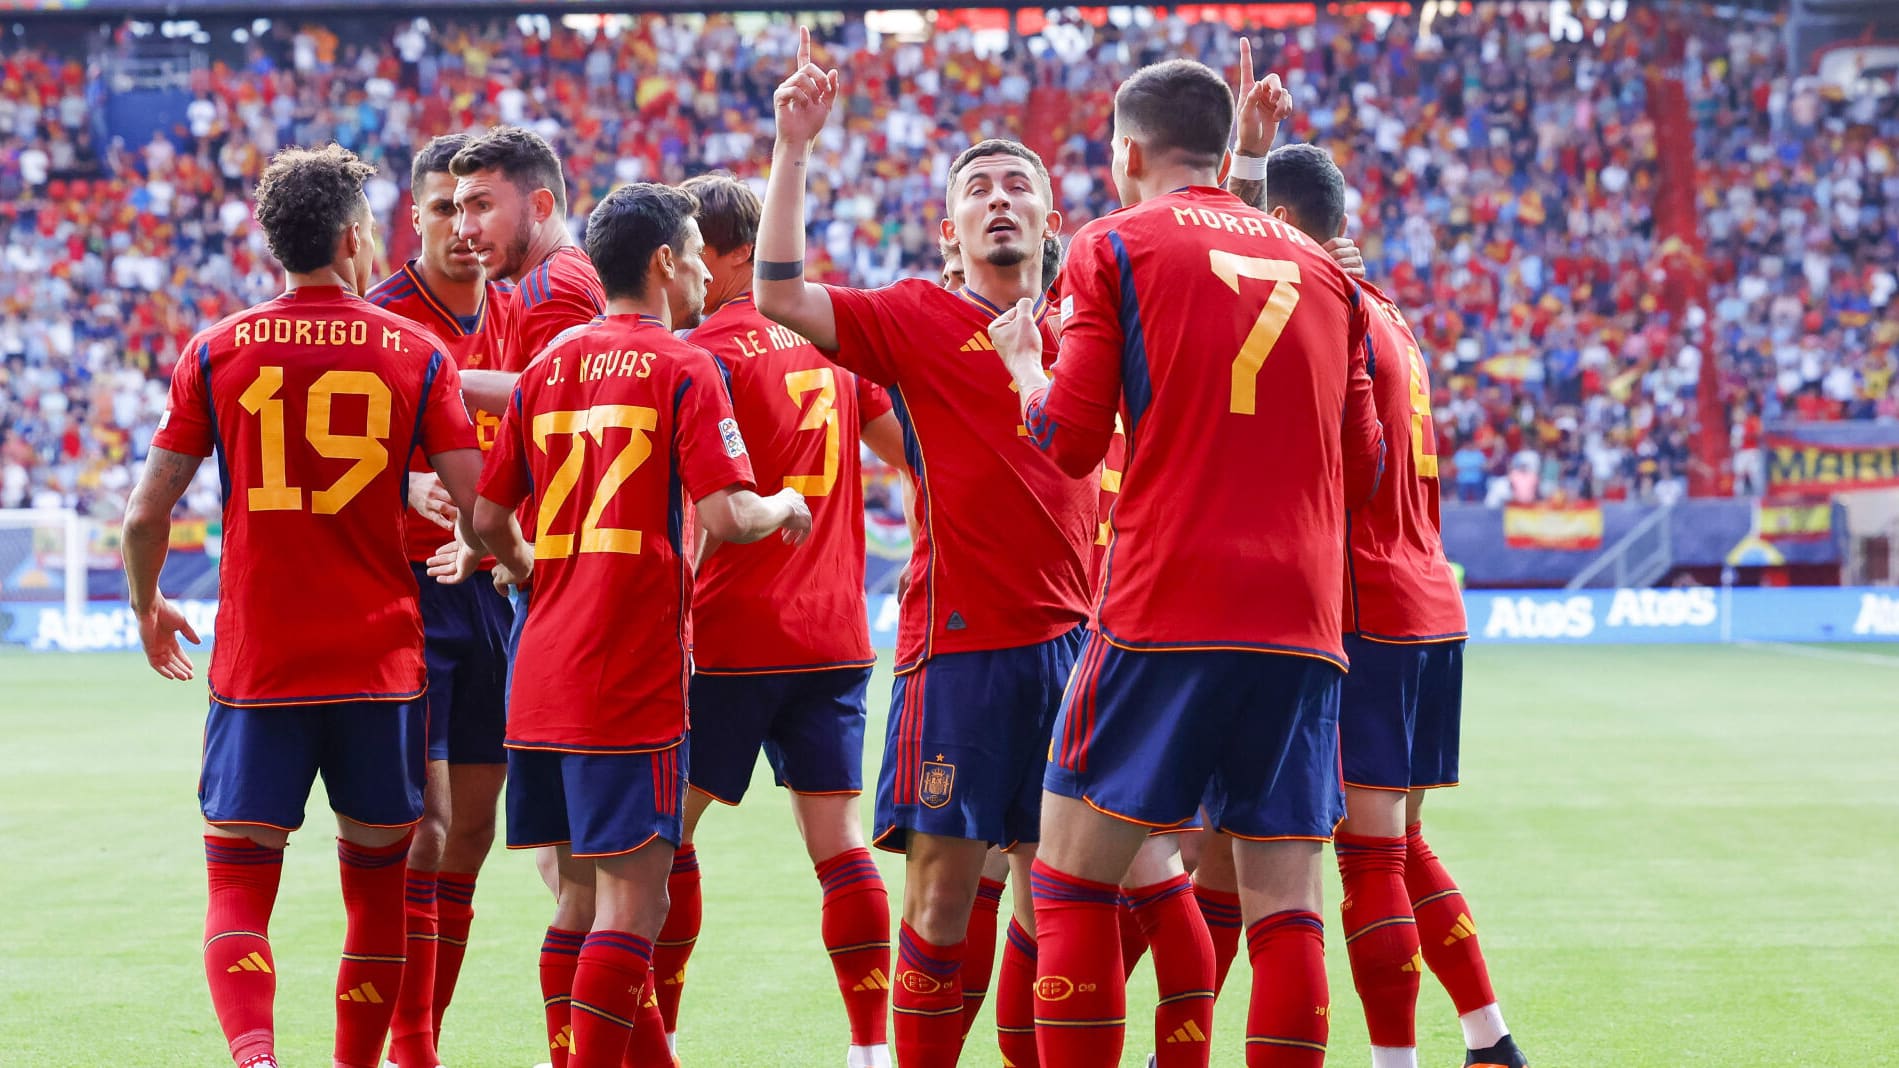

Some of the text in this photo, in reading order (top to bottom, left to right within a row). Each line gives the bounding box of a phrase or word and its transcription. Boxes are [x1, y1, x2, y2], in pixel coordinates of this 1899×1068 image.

[1170, 206, 1306, 247] MORATA
[234, 318, 409, 353] RODRIGO M.
[546, 350, 657, 386] J. NAVAS
[734, 330, 768, 359] LE
[1208, 249, 1302, 416] 7
[238, 366, 392, 515] 19
[783, 367, 840, 497] 3
[532, 404, 658, 560] 22
